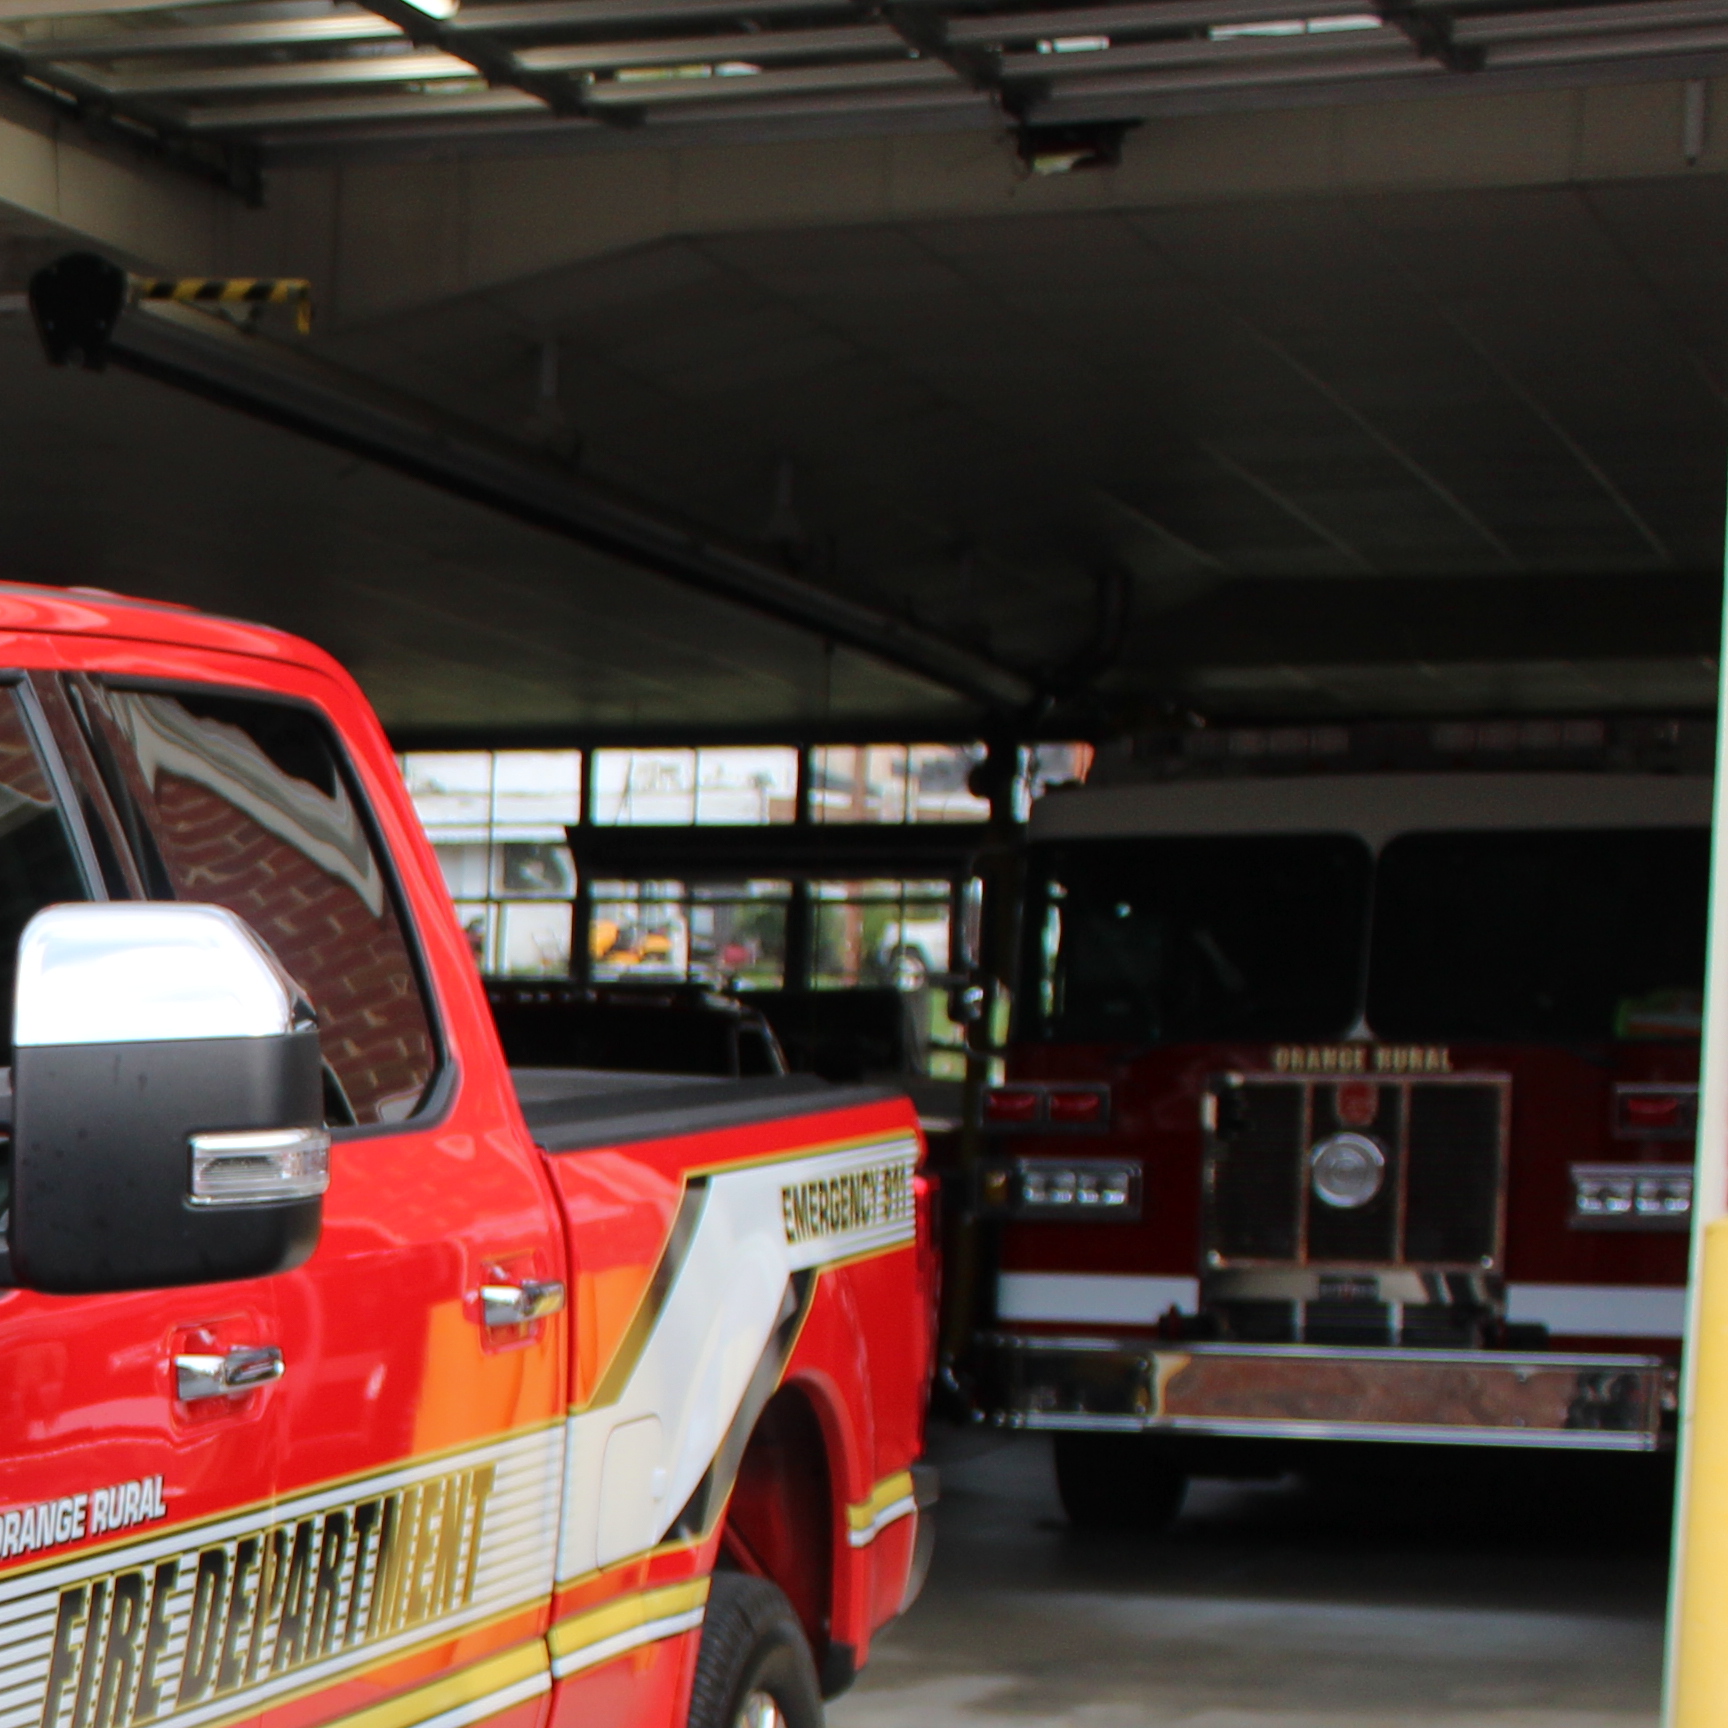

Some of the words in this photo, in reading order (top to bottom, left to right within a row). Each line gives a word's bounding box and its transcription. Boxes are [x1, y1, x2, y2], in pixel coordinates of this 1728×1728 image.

[780, 1167, 878, 1246] EMERGENCY
[91, 1474, 167, 1535] RURAL
[174, 1463, 497, 1712] DEPARTMENT
